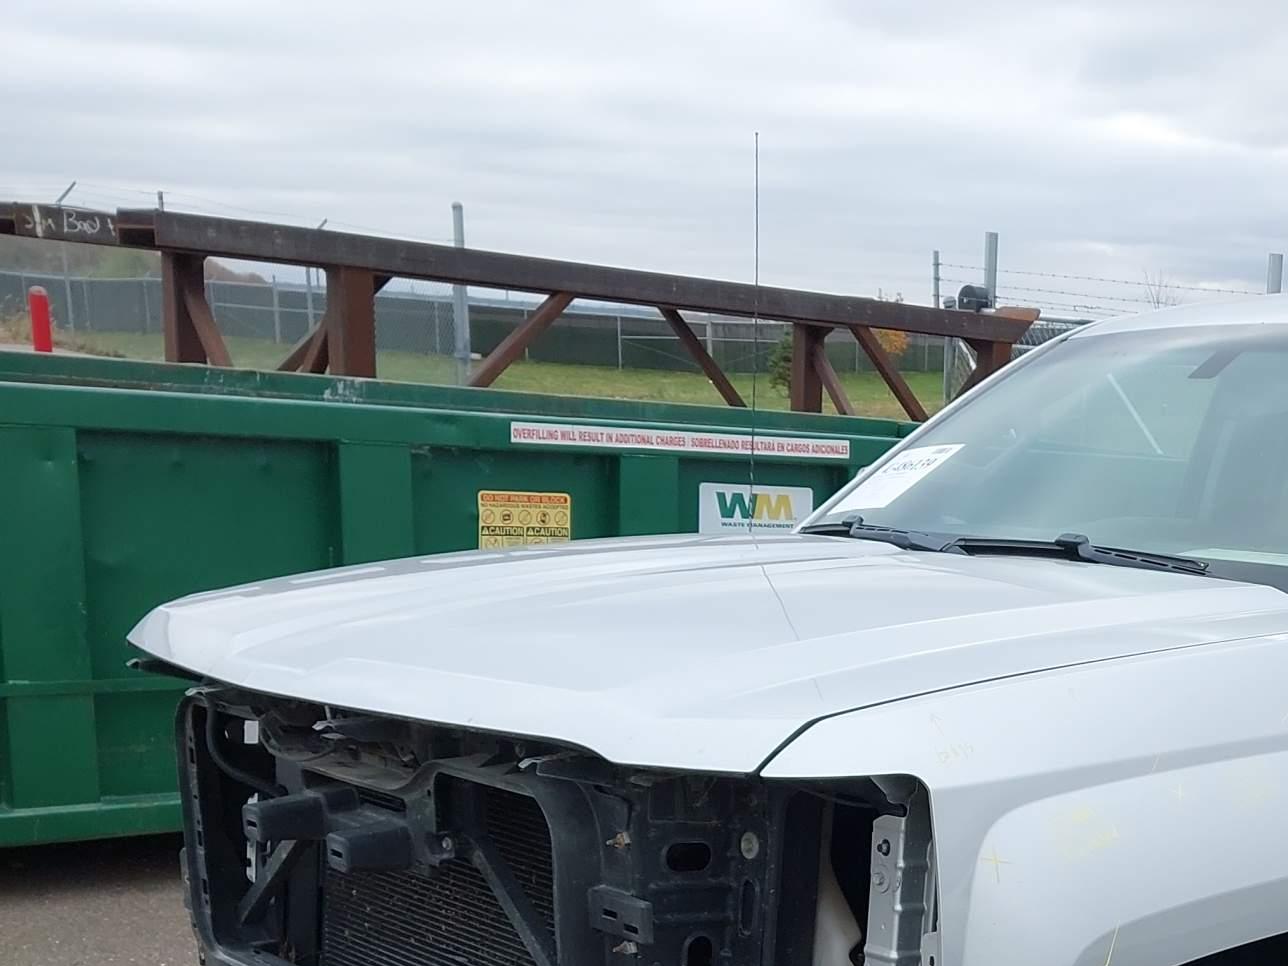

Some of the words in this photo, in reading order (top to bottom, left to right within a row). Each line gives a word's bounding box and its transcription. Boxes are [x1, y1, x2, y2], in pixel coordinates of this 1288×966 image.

[513, 428, 558, 440] OVERFILLING
[560, 430, 577, 441] WILL
[578, 431, 604, 442] RESULT
[606, 433, 615, 443] IN
[615, 433, 655, 445] ADDITIONAL
[656, 435, 686, 447] CHARGES
[691, 437, 740, 449] SOBRELLENADO
[777, 441, 785, 452] EN
[786, 441, 810, 452] CARGOS
[812, 442, 848, 455] ADICIONALES
[716, 491, 793, 520] WM
[489, 527, 523, 535] CAUTION
[534, 527, 568, 536] CAUTION
